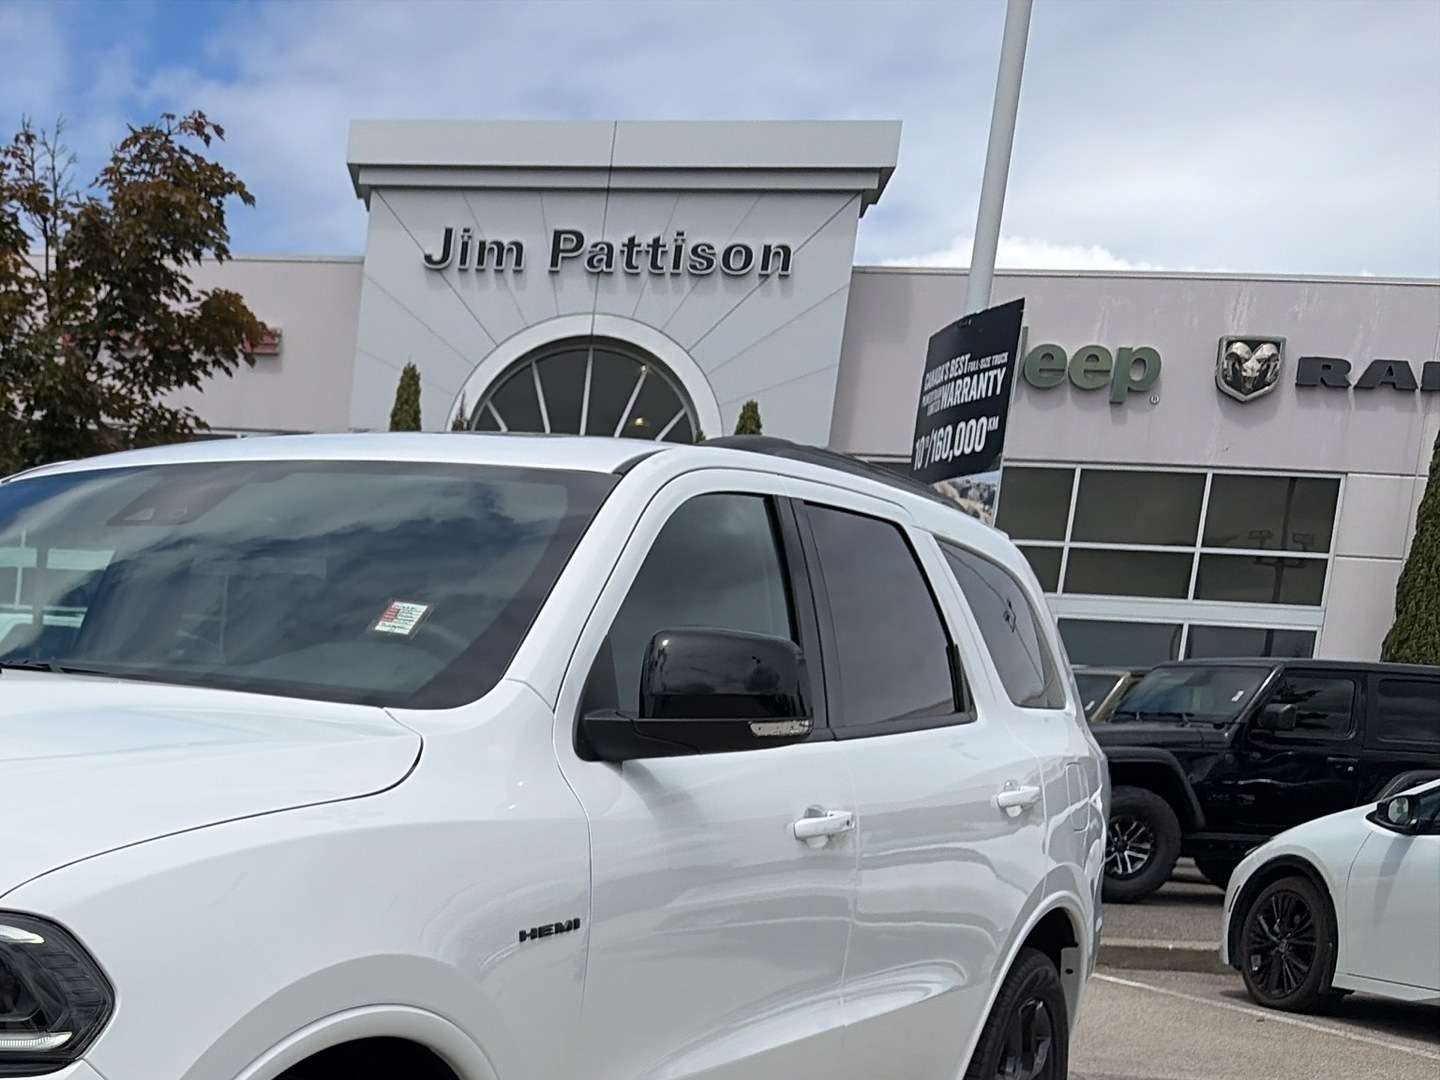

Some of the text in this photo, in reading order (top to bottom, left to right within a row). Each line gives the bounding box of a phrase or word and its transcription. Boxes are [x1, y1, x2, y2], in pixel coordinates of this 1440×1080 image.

[424, 227, 794, 278] Jim Pattison
[949, 353, 971, 379] BEST
[940, 366, 1007, 410] WARRANTY
[518, 918, 580, 943] HEMI
